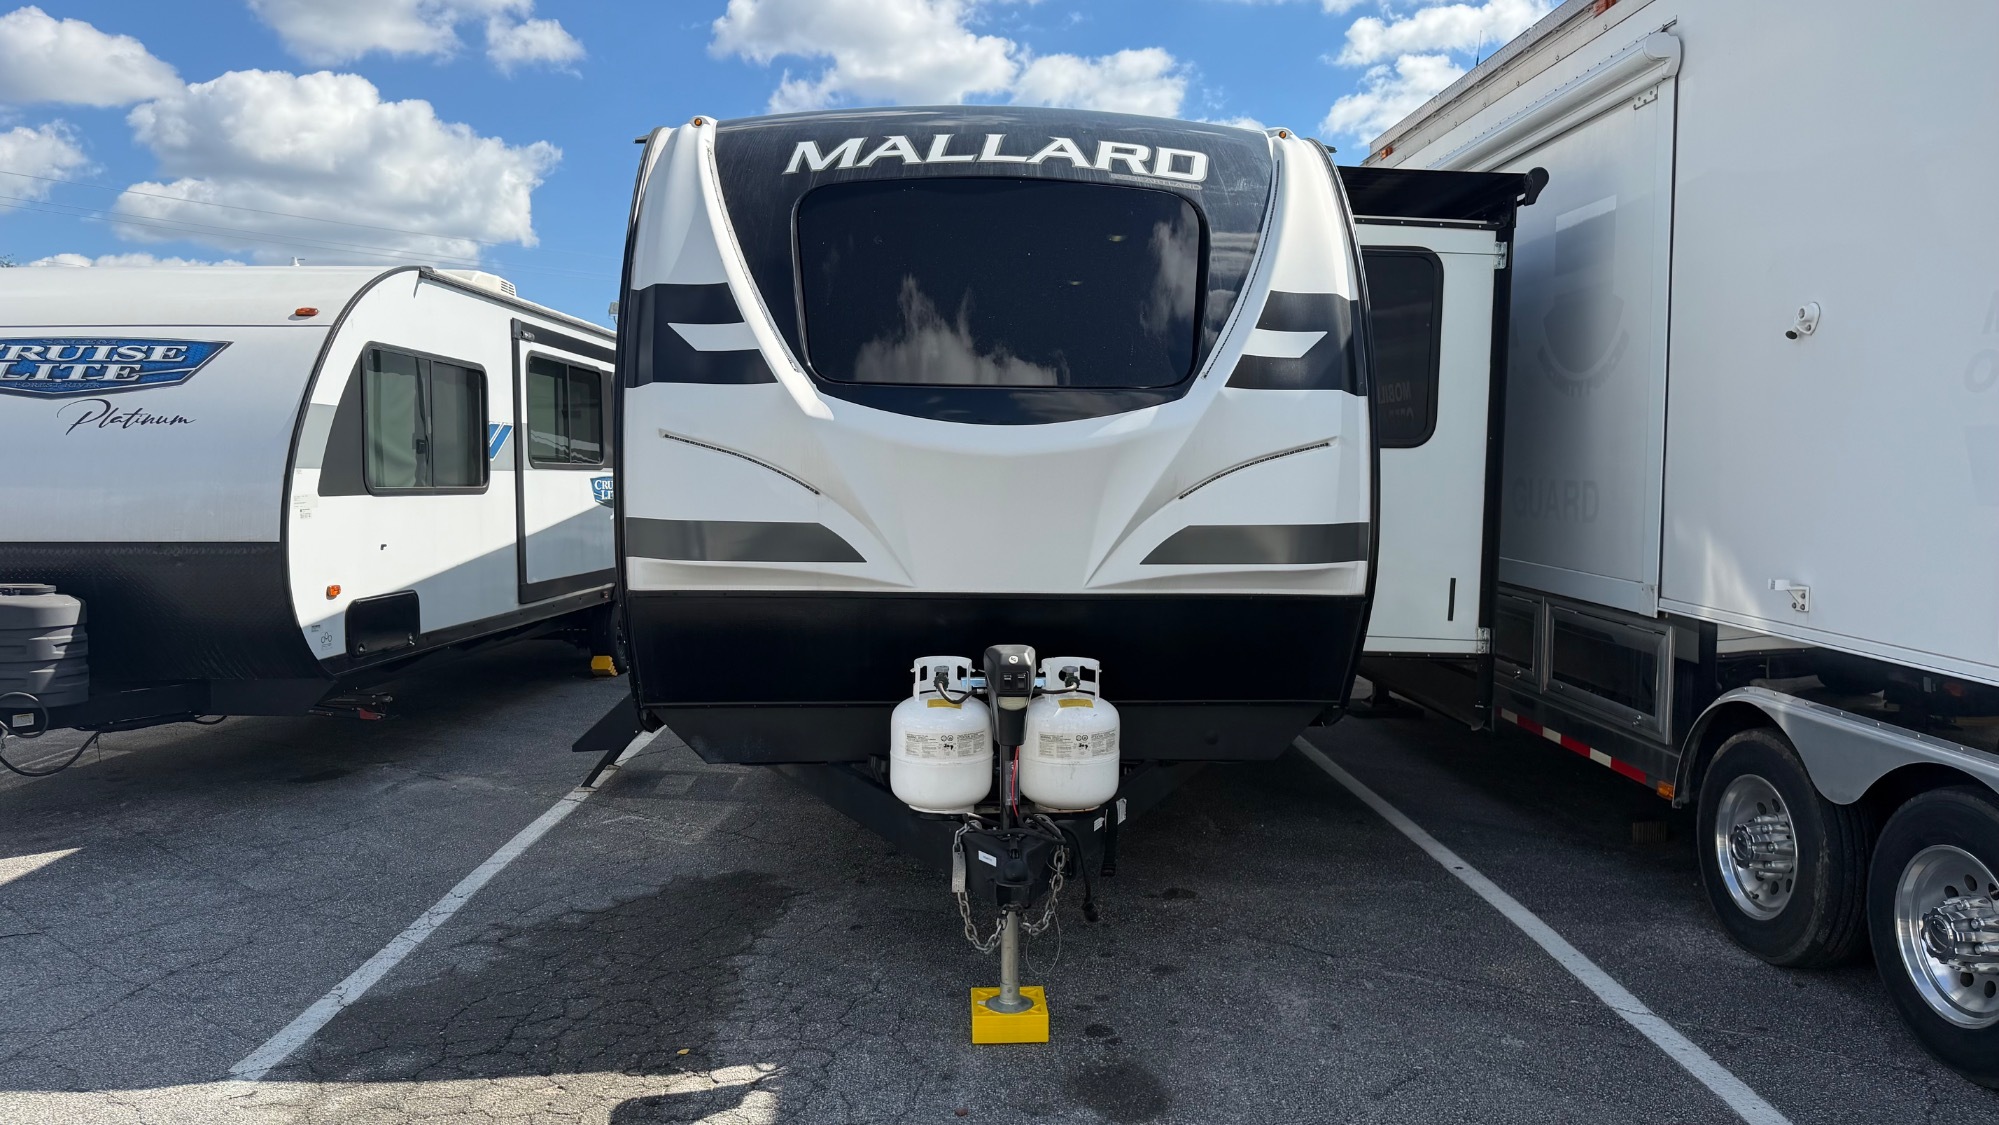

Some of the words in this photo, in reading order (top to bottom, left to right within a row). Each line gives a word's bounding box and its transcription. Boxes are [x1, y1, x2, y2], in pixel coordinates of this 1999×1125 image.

[781, 133, 1209, 182] MALLARD
[1131, 176, 1201, 190] HEARTLAND
[0, 344, 188, 362] RUISE
[0, 362, 141, 381] LITE
[56, 398, 197, 436] Platinum
[1512, 477, 1600, 523] GUARD
